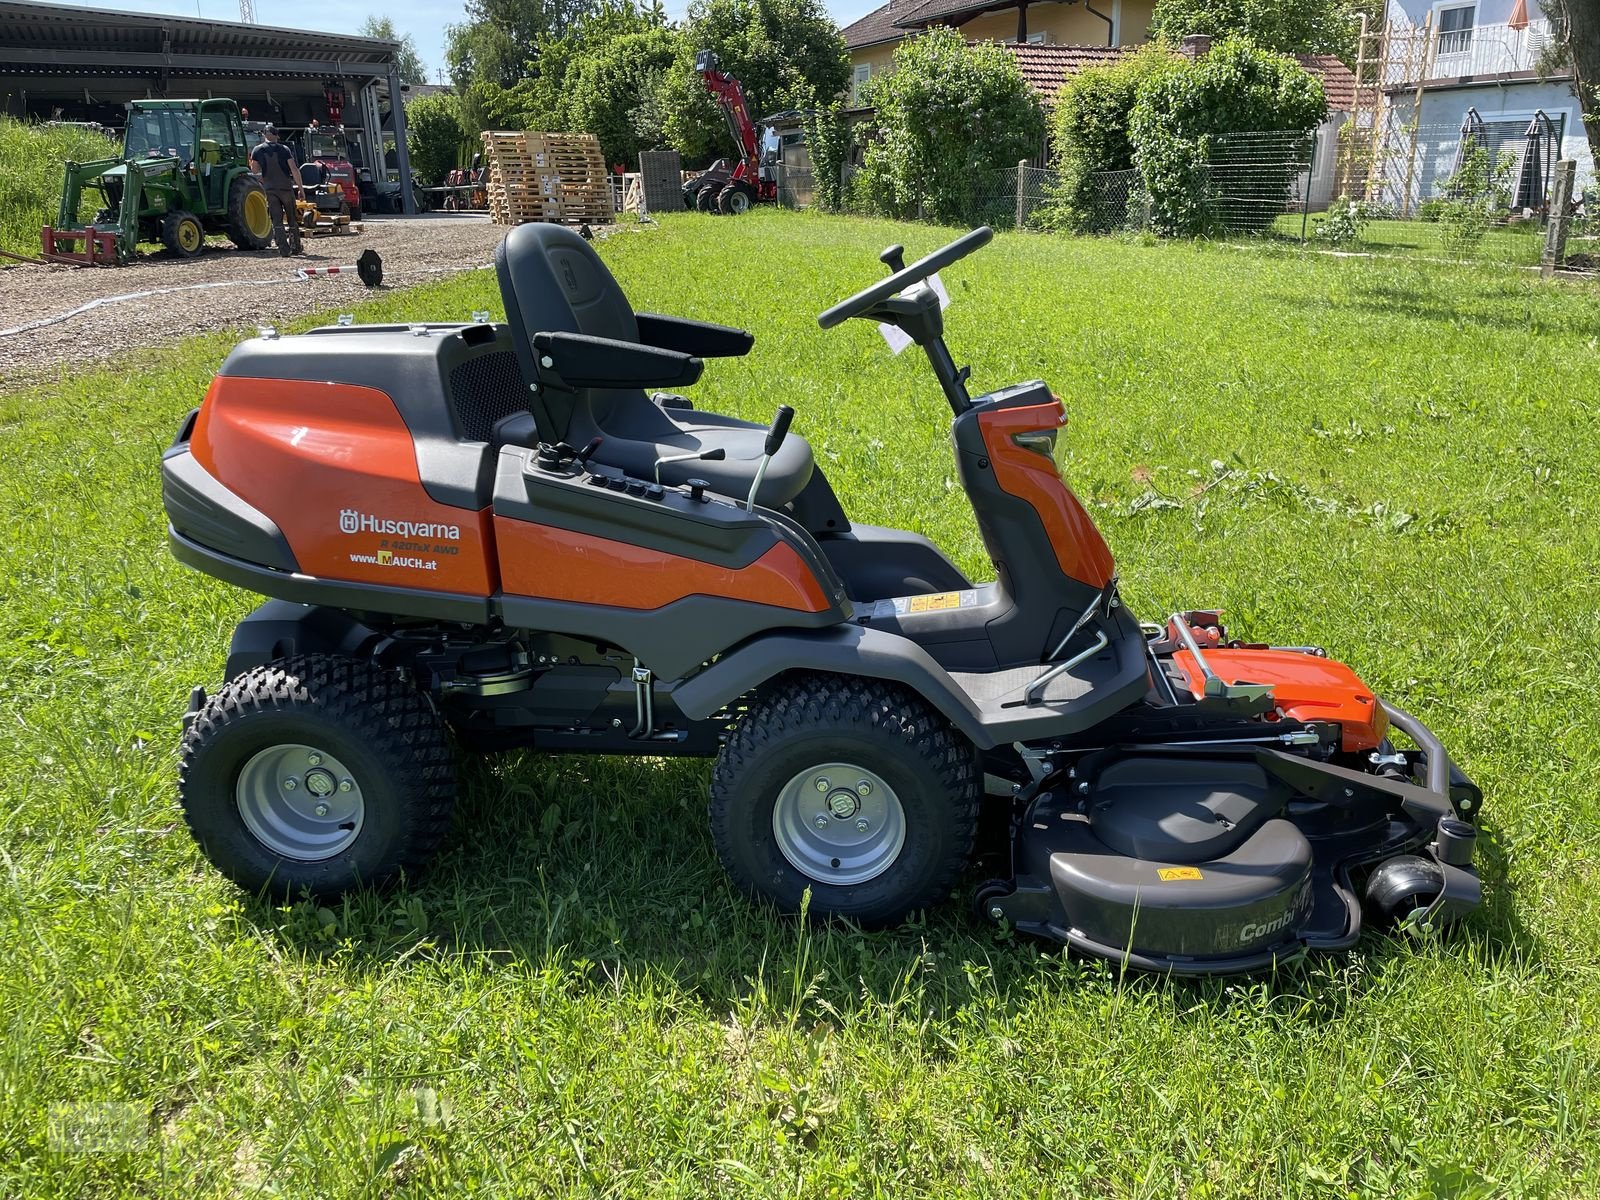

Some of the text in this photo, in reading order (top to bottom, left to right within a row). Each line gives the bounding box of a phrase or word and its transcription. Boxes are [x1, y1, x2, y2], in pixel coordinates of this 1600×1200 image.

[360, 514, 460, 539] Husqvarna
[433, 545, 459, 555] AWD
[350, 553, 437, 570] www.MAUCH.at
[1240, 909, 1295, 941] Combi
